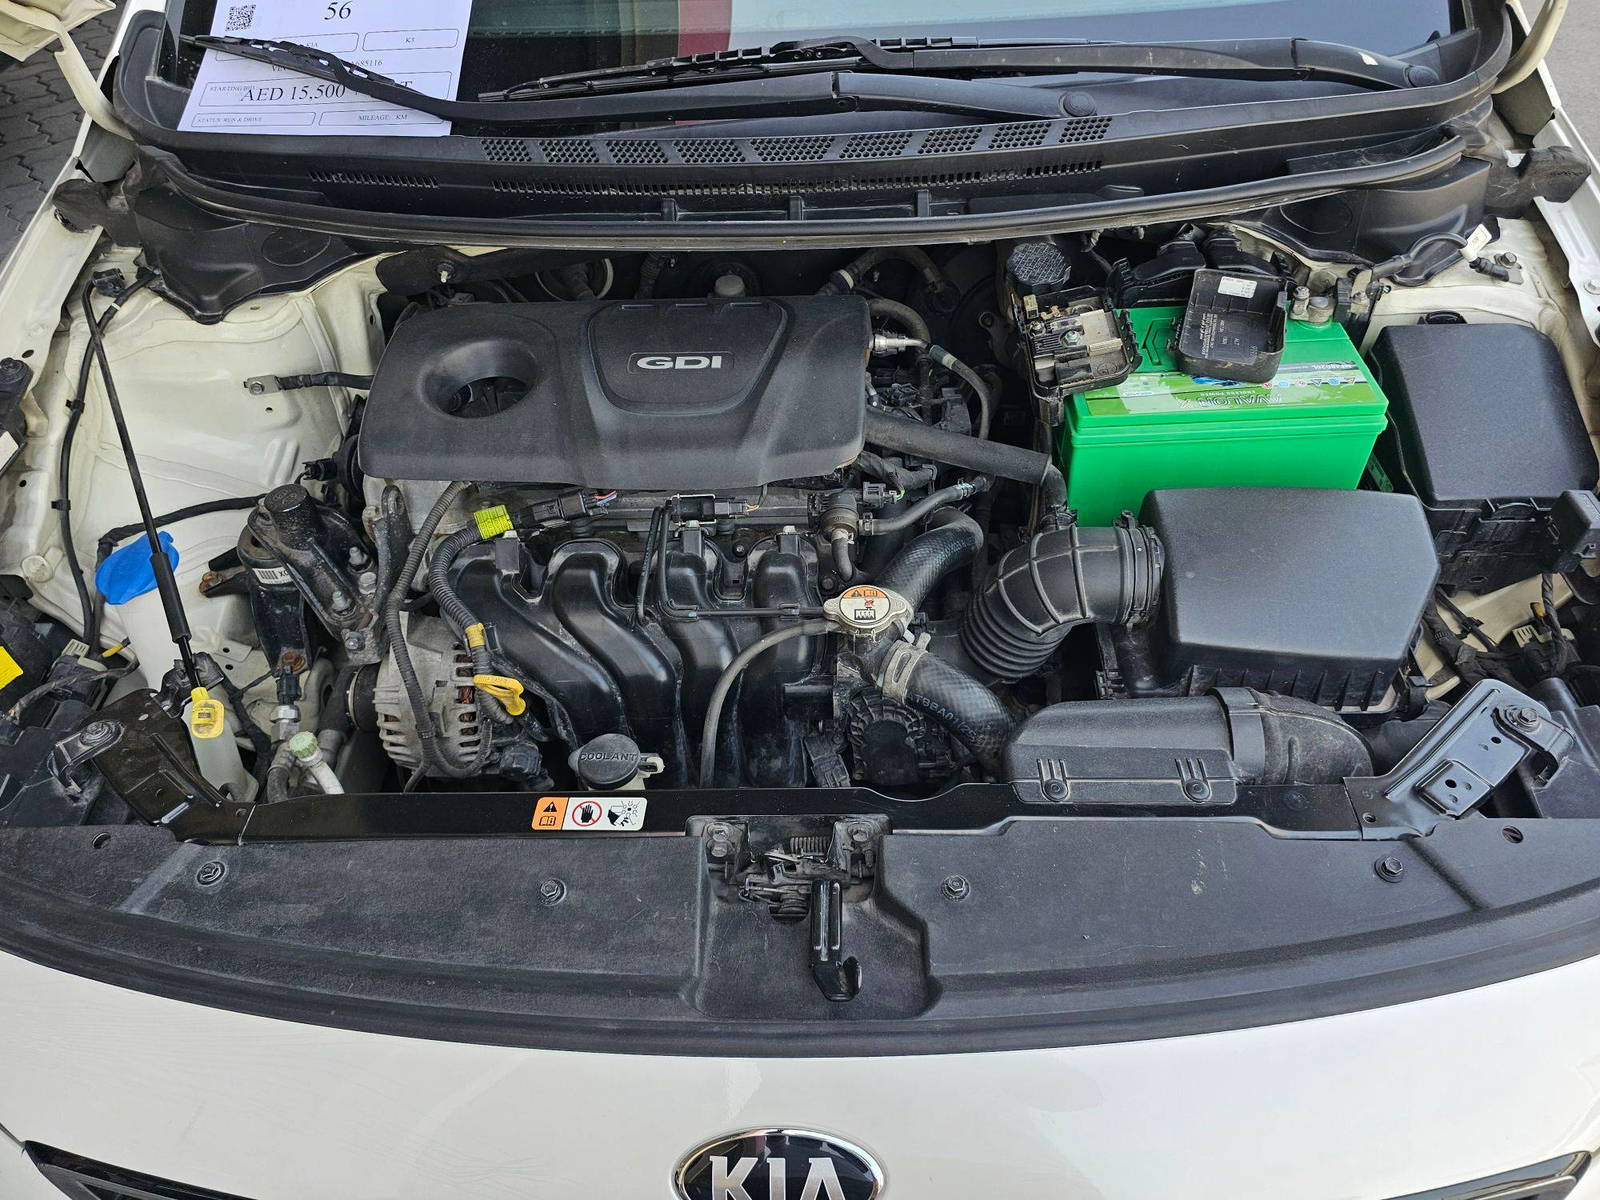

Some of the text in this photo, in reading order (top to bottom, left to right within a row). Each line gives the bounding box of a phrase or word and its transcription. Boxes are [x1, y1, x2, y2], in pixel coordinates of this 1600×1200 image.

[324, 1, 352, 20] 56
[240, 87, 283, 102] AED
[636, 355, 722, 370] GDI
[580, 752, 639, 761] COOLANT
[710, 1155, 847, 1200] KIA
